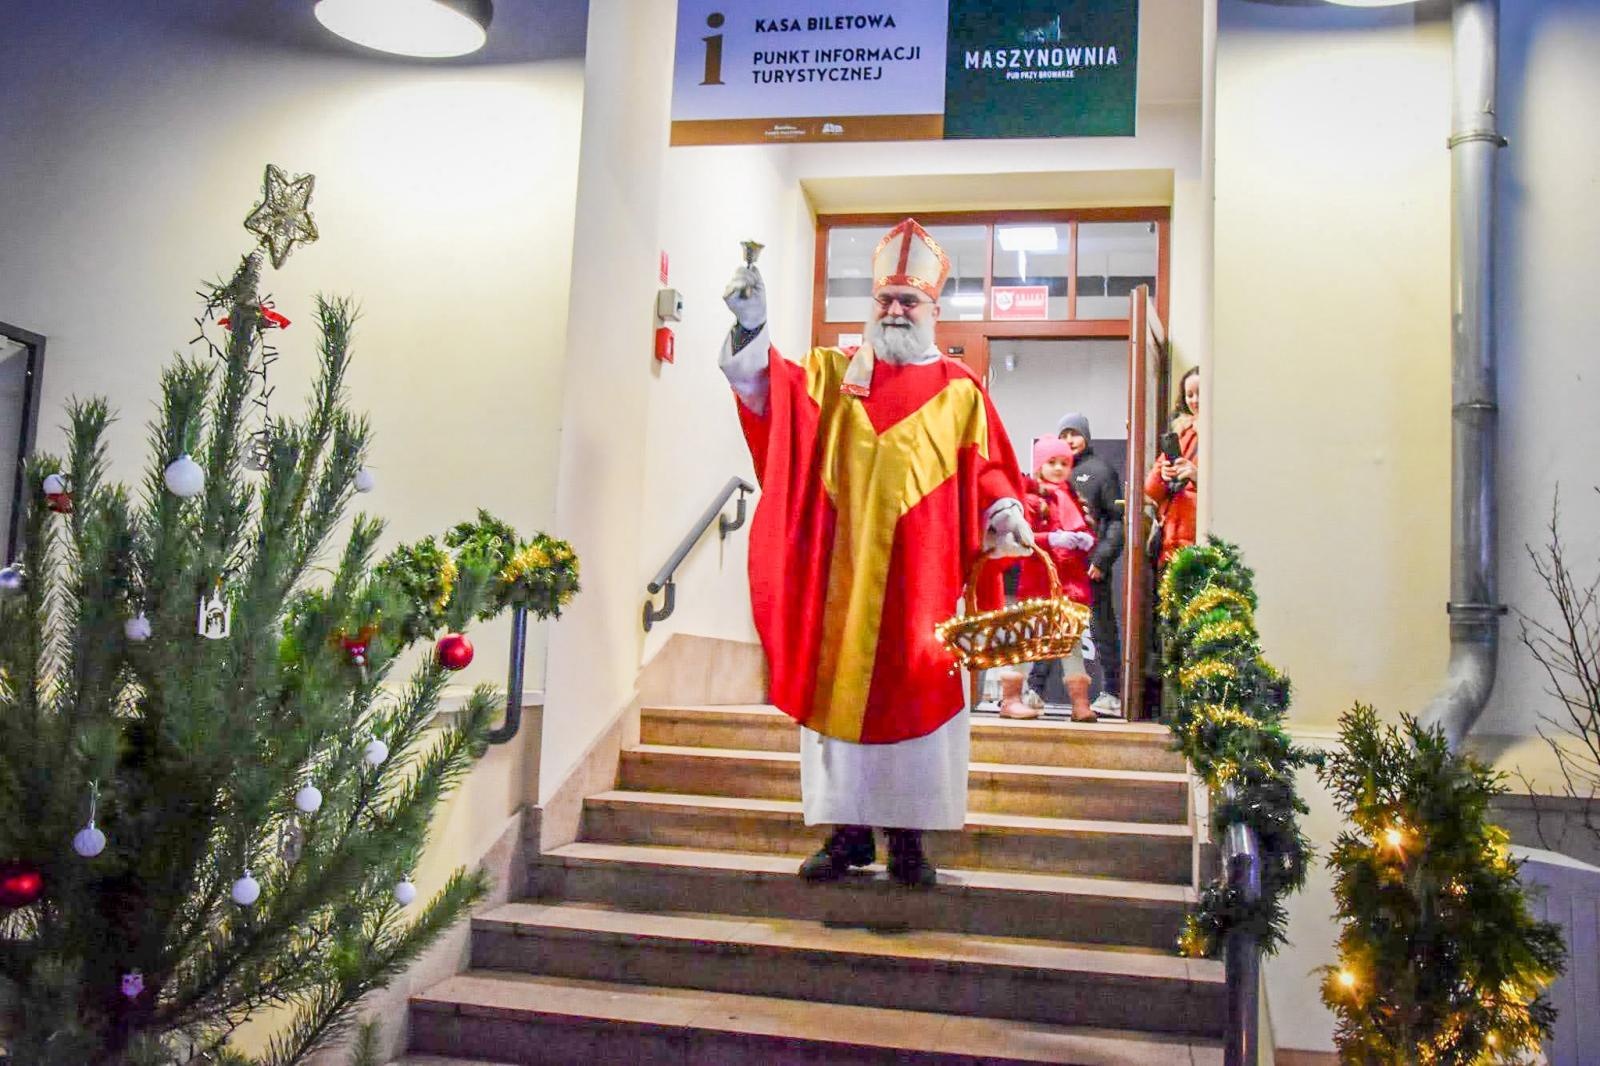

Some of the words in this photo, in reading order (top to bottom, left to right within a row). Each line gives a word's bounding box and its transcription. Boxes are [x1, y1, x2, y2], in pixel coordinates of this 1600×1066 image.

[755, 18, 801, 33] KASA
[807, 14, 896, 31] BILETOWA
[753, 49, 810, 65] PUNKT
[815, 46, 921, 63] INFORMACJI
[965, 46, 1118, 69] MASZYNOWNIA
[752, 66, 882, 84] TURYSTYCZNEJ
